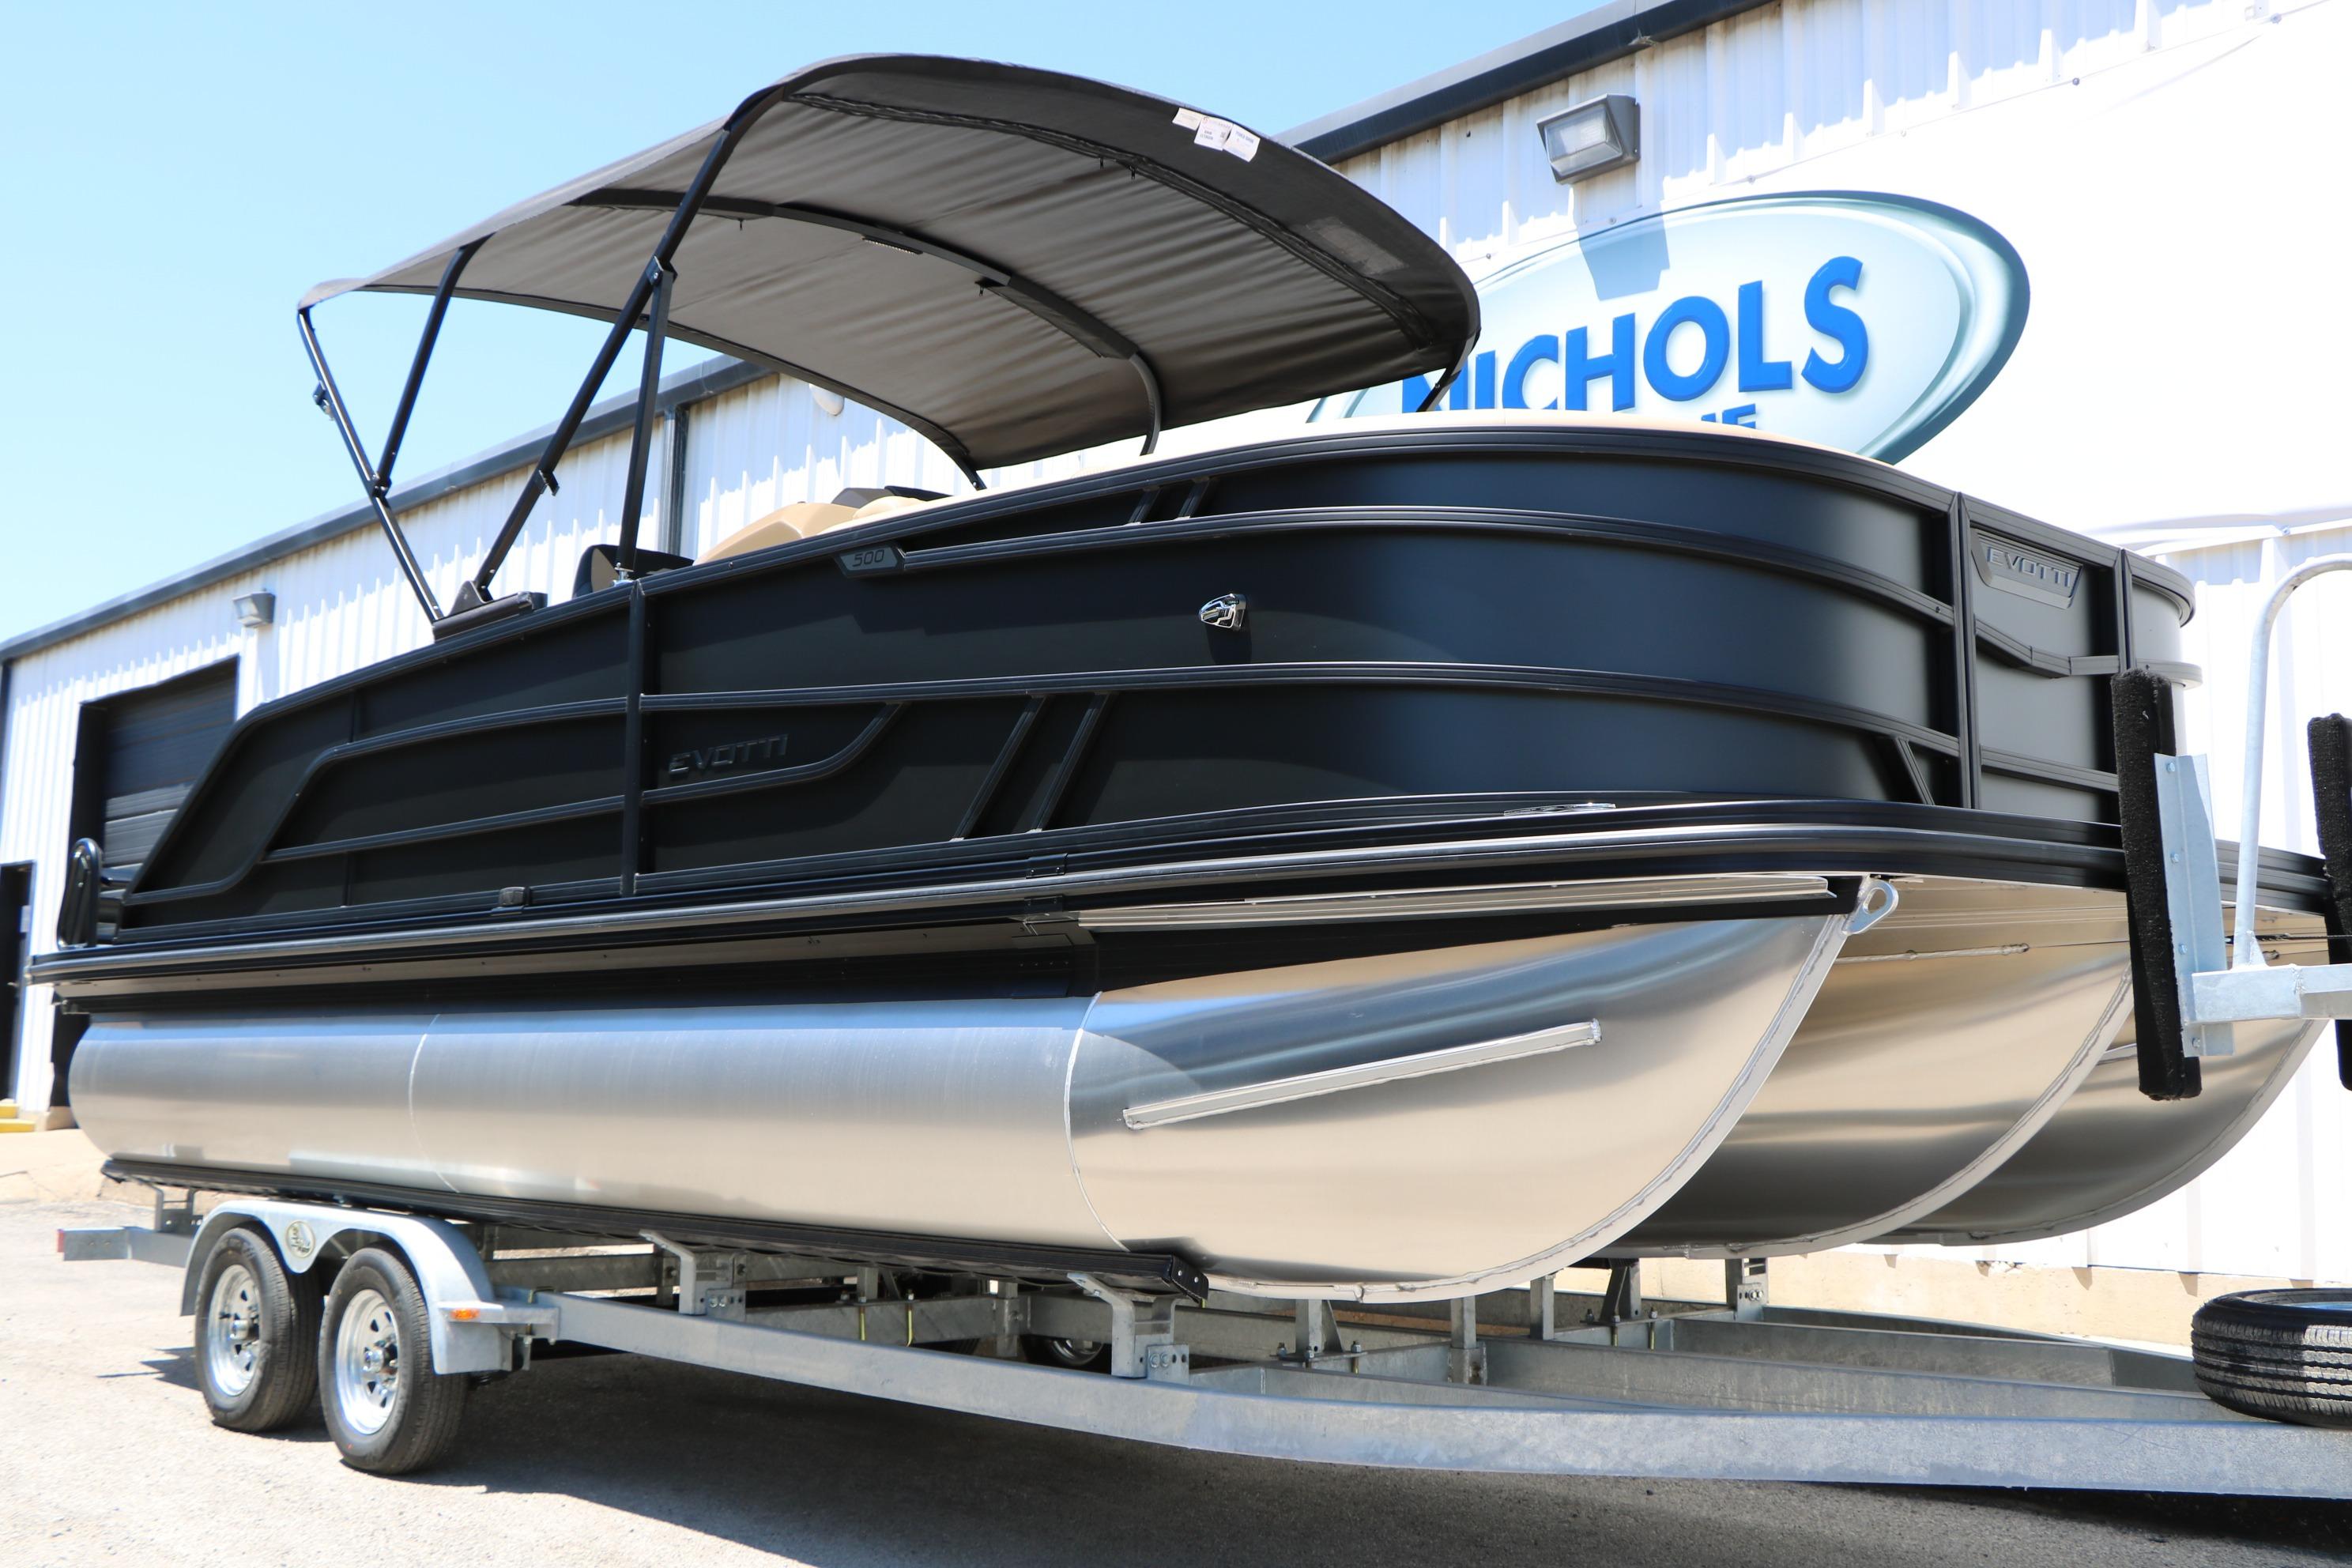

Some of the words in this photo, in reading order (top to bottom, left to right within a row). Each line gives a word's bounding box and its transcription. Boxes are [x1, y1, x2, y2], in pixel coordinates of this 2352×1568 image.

[853, 549, 885, 567] 500
[1987, 546, 2071, 587] EVOTTI
[669, 733, 789, 772] EVOTTI
